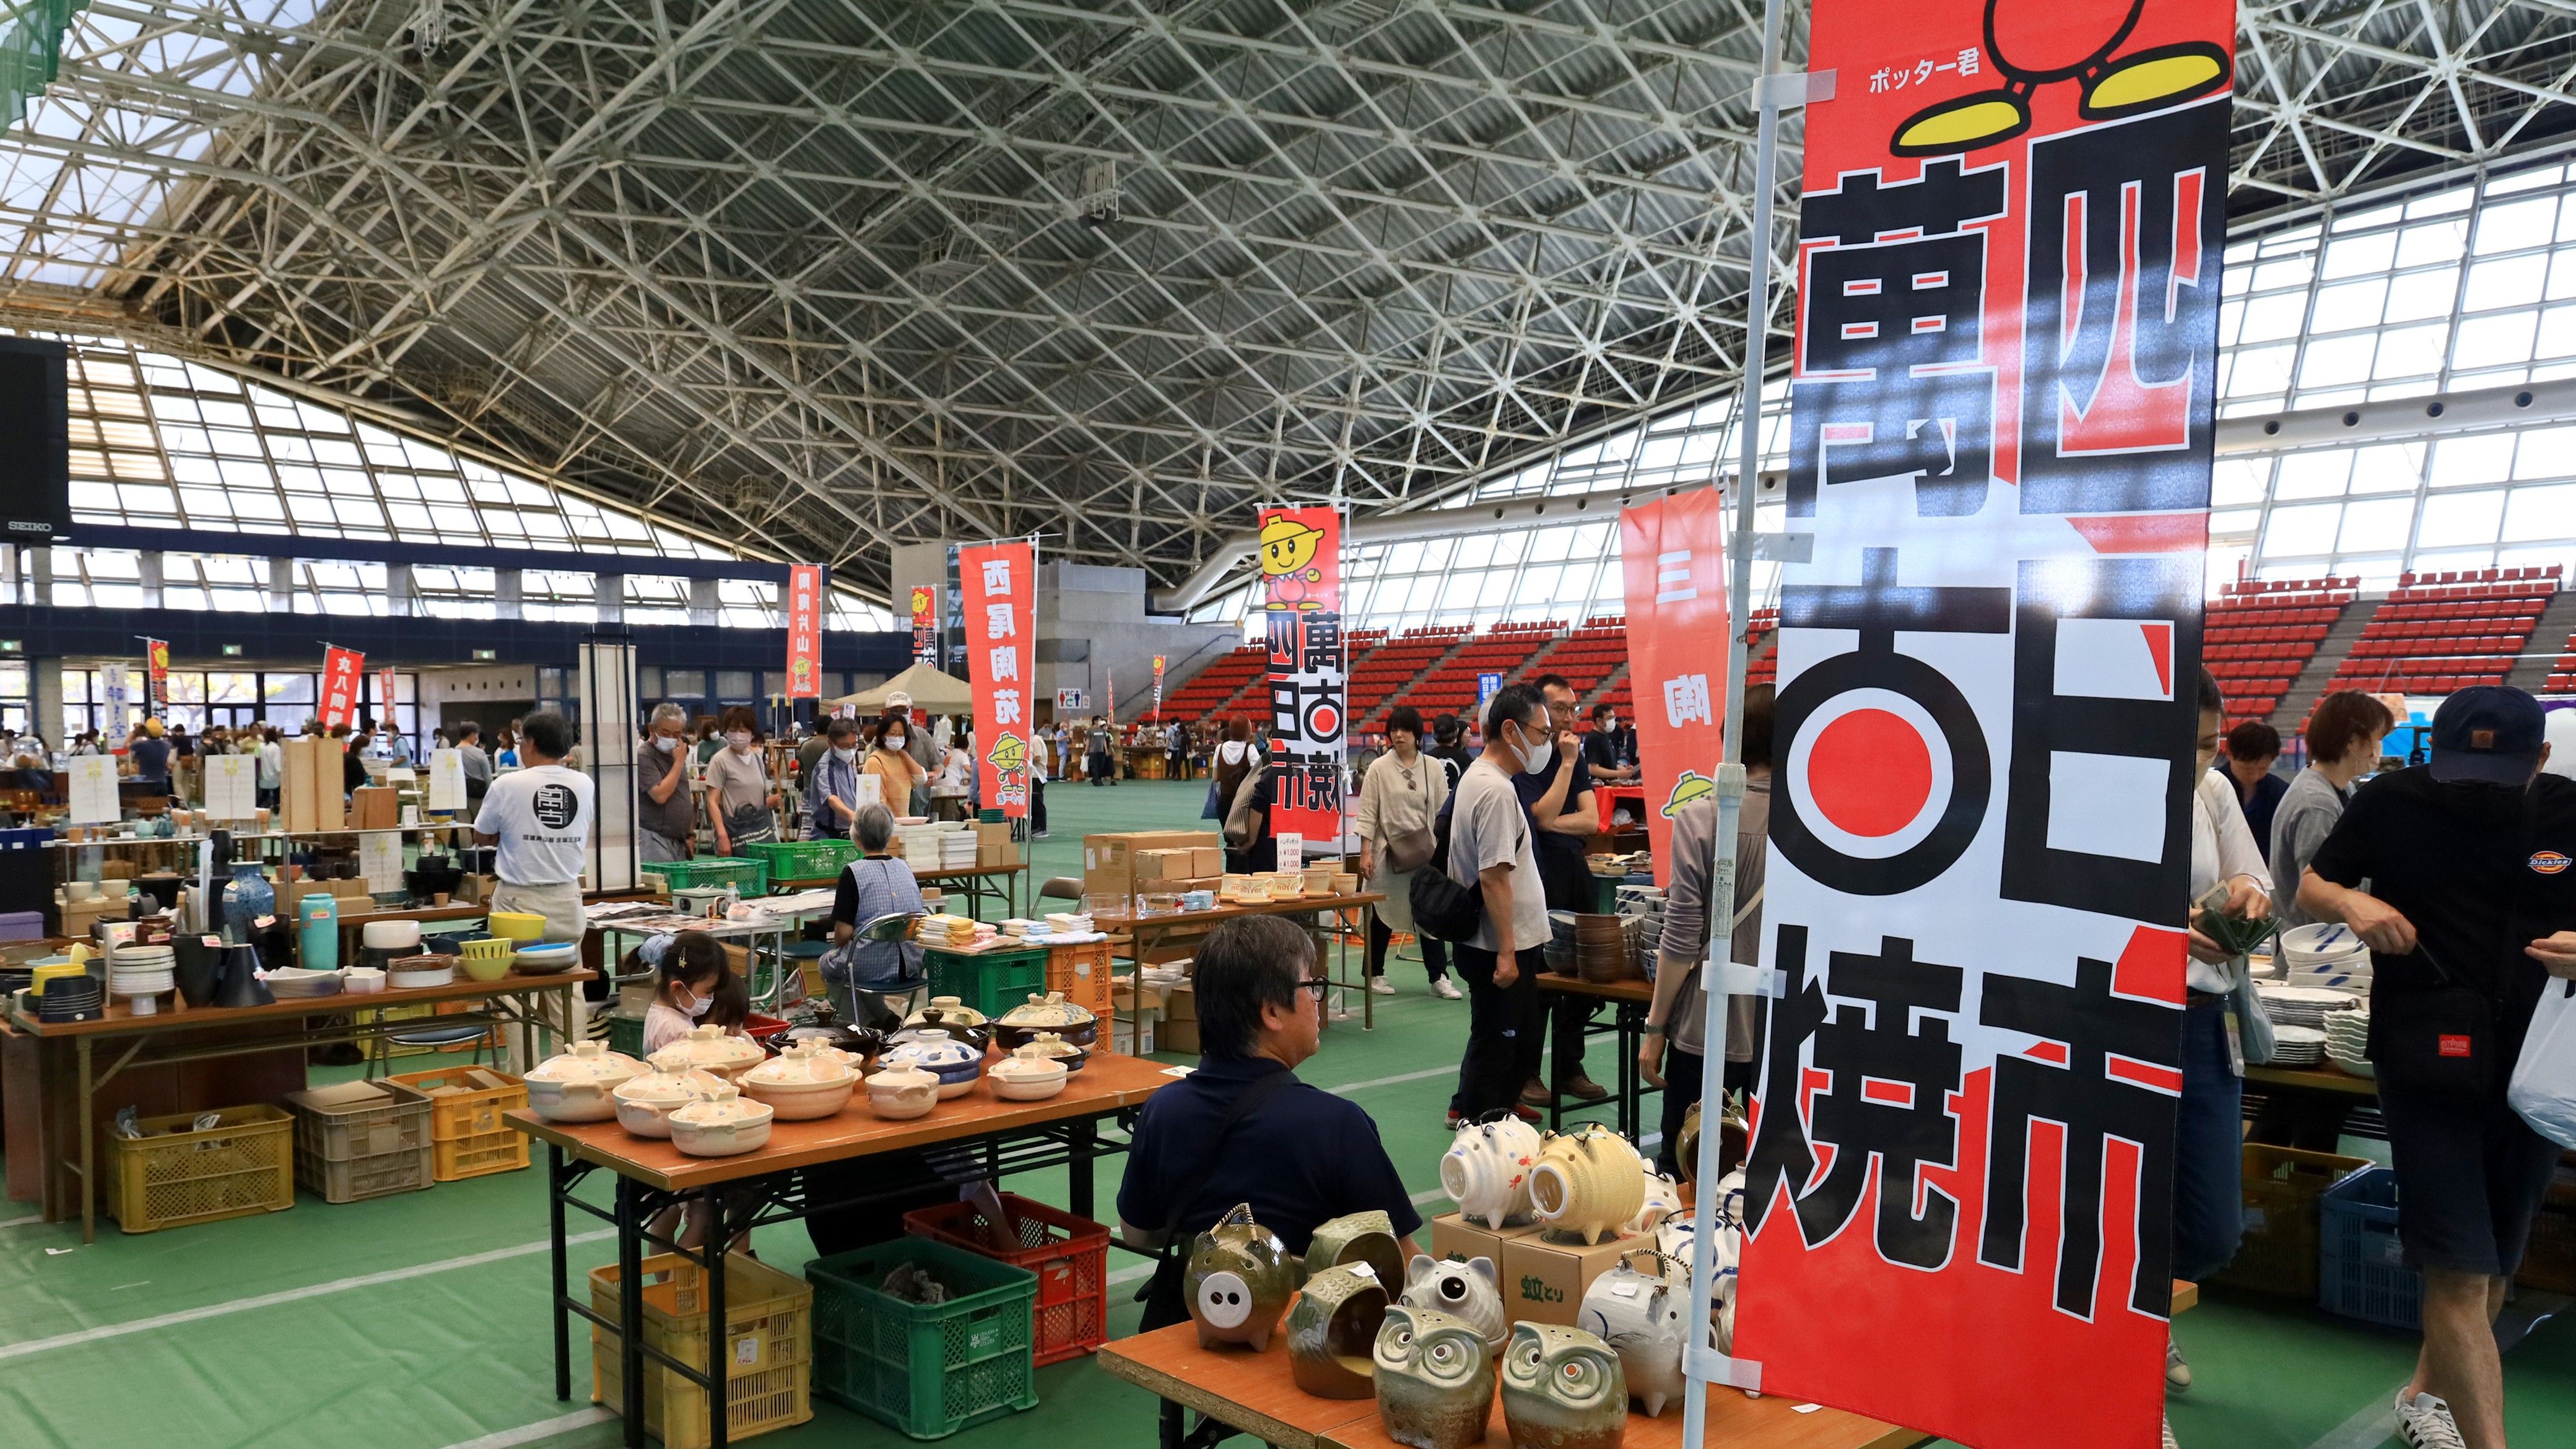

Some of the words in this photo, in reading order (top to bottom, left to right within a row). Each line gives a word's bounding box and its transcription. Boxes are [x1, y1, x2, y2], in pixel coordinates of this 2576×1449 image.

[1869, 46, 1980, 94] ポッター君
[8, 521, 52, 532] SEIKO
[1742, 154, 2011, 1273] 萬古焼
[1521, 1274, 1564, 1303] 蚊とり
